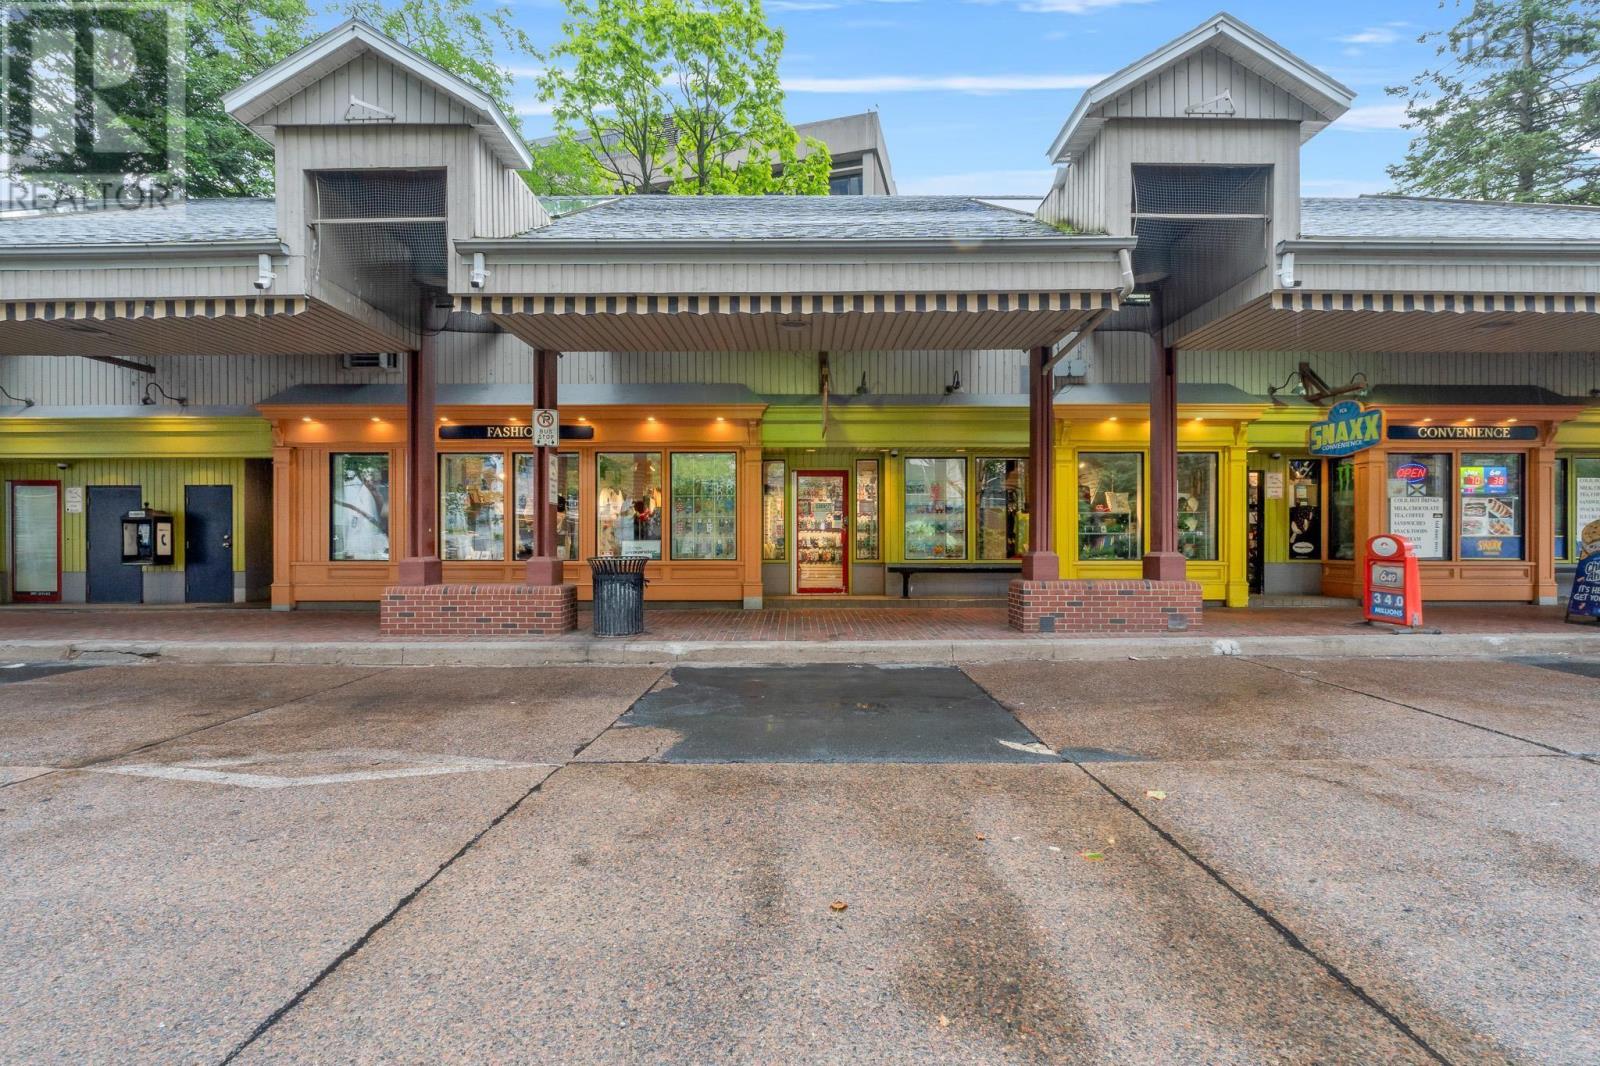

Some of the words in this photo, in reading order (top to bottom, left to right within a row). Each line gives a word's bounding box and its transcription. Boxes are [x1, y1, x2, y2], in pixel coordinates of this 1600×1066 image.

[487, 426, 533, 438] FASHIO
[1311, 413, 1380, 450] SNAXX
[1417, 427, 1510, 439] CONVENIENCE
[1396, 467, 1426, 478] OPEN
[1578, 585, 1590, 593] IT'S
[1591, 586, 1600, 594] HE
[1590, 594, 1600, 602] YO
[1374, 607, 1404, 617] MILLIONS
